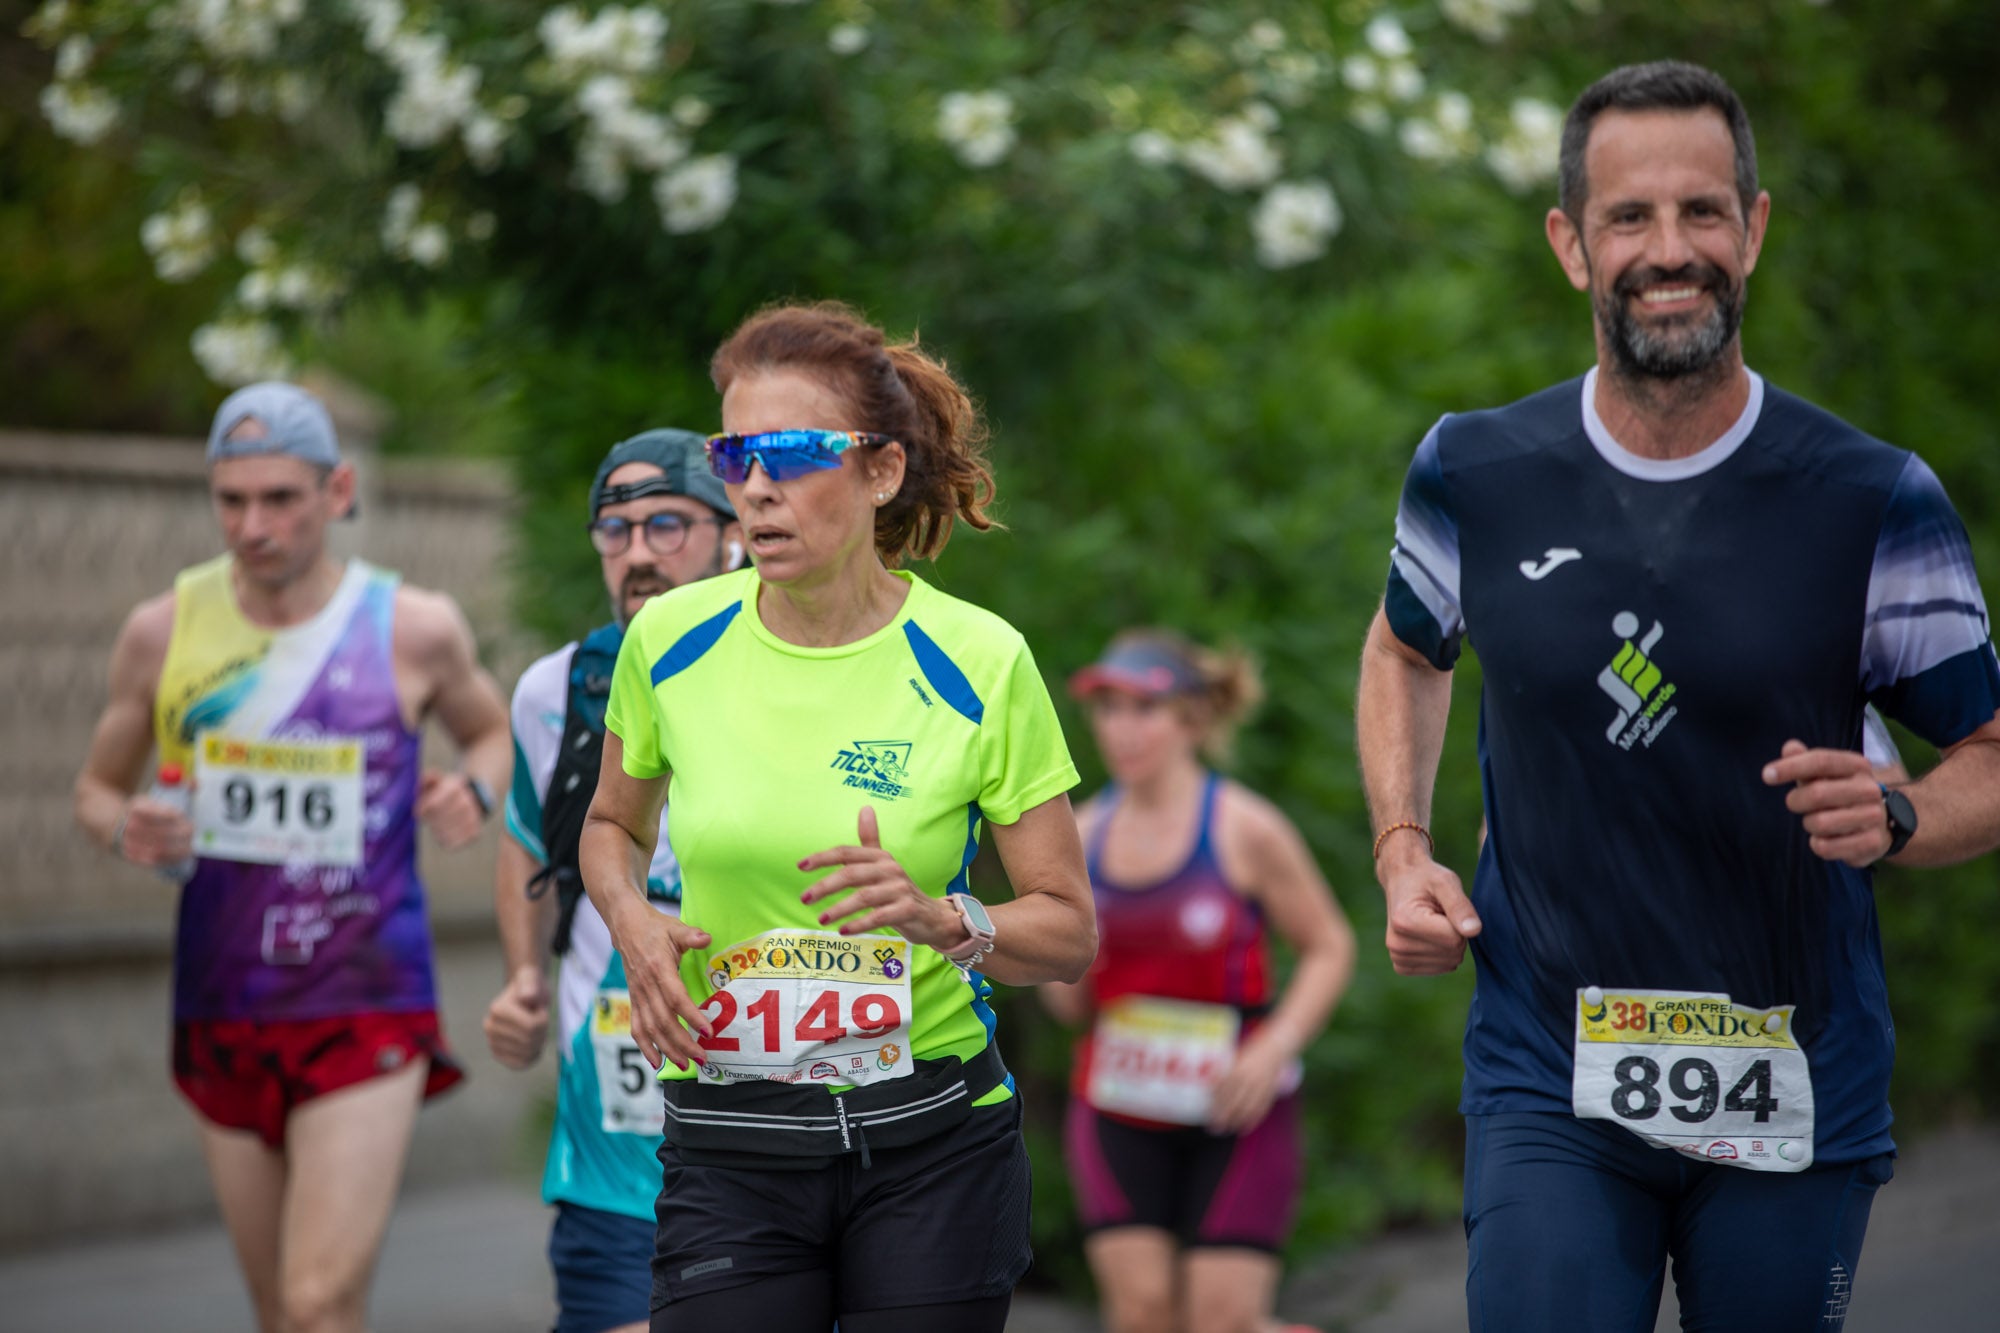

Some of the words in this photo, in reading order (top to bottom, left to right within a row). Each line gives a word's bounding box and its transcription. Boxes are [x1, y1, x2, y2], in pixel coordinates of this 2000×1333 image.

[1618, 683, 1677, 751] Murgiverde
[842, 774, 902, 796] RUNNERS
[222, 775, 335, 831] 916
[799, 938, 852, 950] PREMIO
[853, 944, 861, 952] DI
[1610, 1001, 1648, 1031] 38
[1655, 1001, 1697, 1013] GRAN
[697, 989, 902, 1053] 2149
[724, 1069, 764, 1081] Cruzcampo
[847, 1067, 870, 1076] ABADES
[1610, 1054, 1779, 1124] 894
